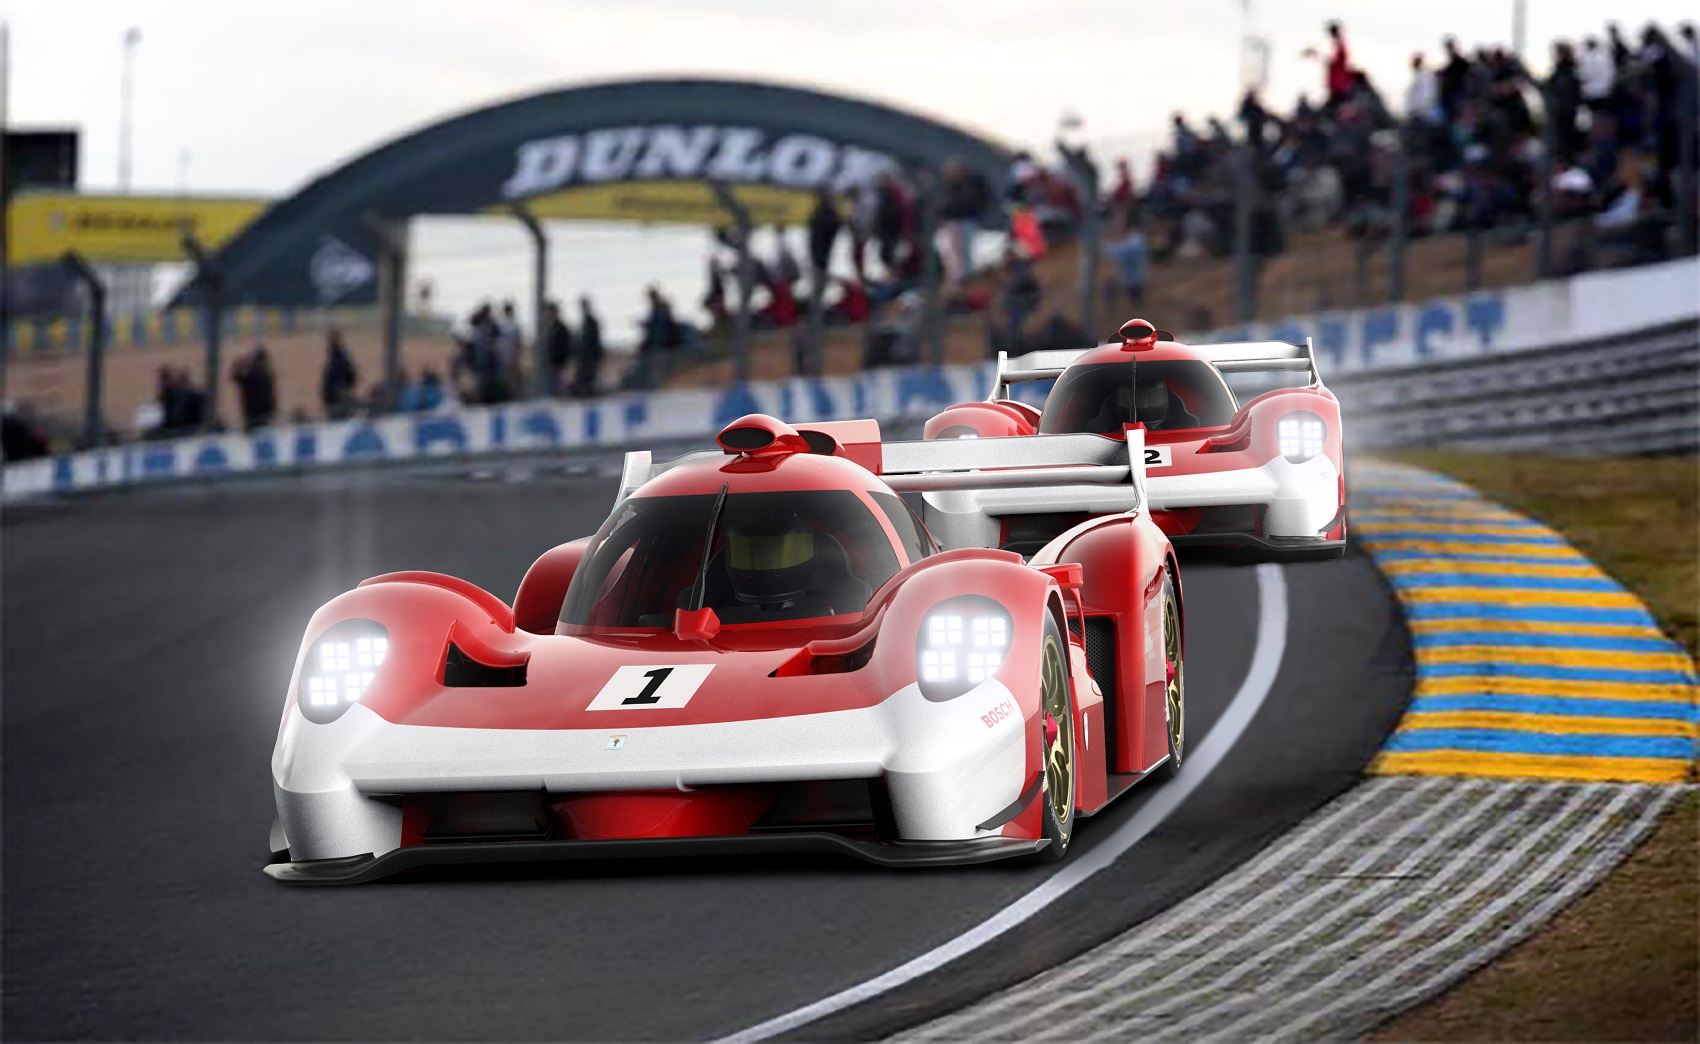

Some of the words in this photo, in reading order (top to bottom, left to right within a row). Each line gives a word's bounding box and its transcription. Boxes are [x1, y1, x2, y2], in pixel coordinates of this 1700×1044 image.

[1144, 449, 1162, 465] 2
[620, 667, 675, 705] 1
[980, 698, 1014, 729] BOSCH
